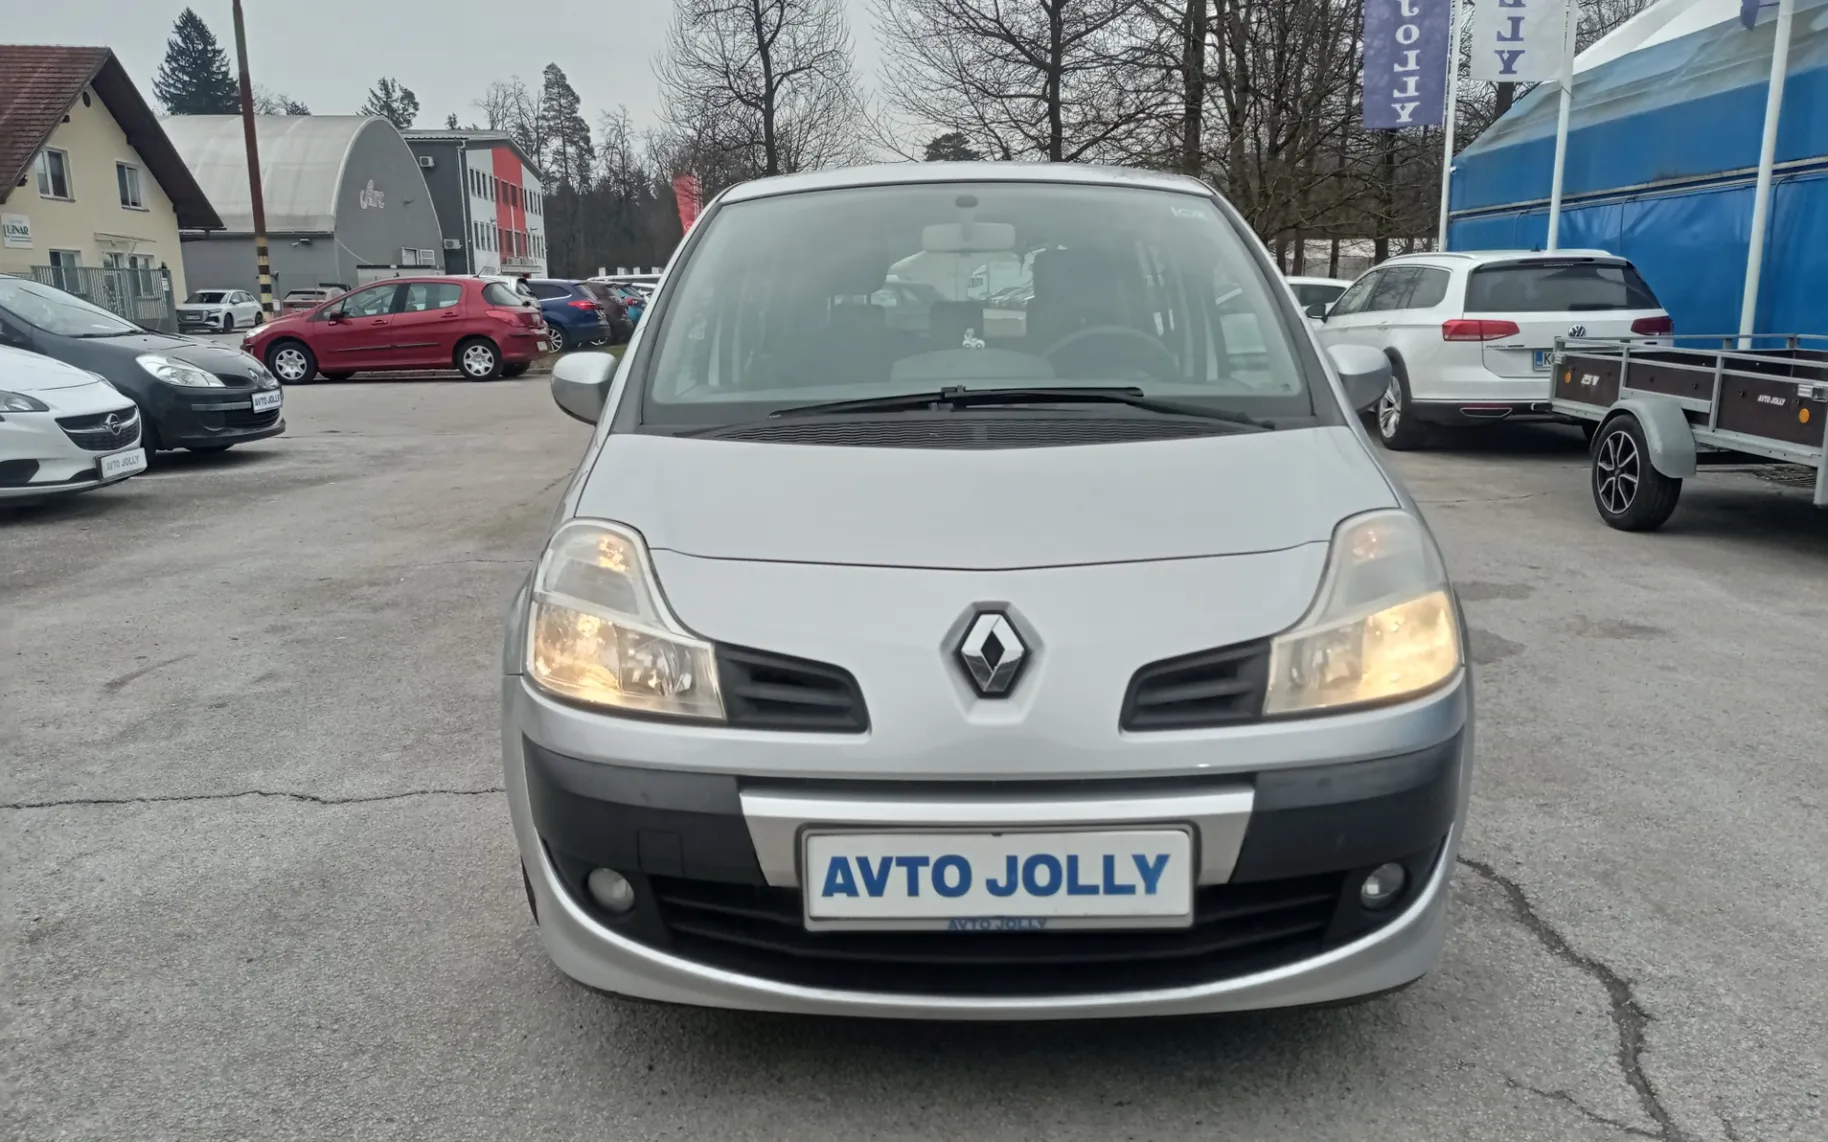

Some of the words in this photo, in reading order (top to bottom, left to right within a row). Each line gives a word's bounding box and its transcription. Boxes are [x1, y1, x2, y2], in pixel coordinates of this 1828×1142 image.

[121, 455, 140, 468] JOLLY
[821, 855, 972, 898] AVTO
[985, 854, 1170, 897] JOLLY
[947, 918, 991, 931] AVTO
[994, 918, 1047, 931] JOLLY
